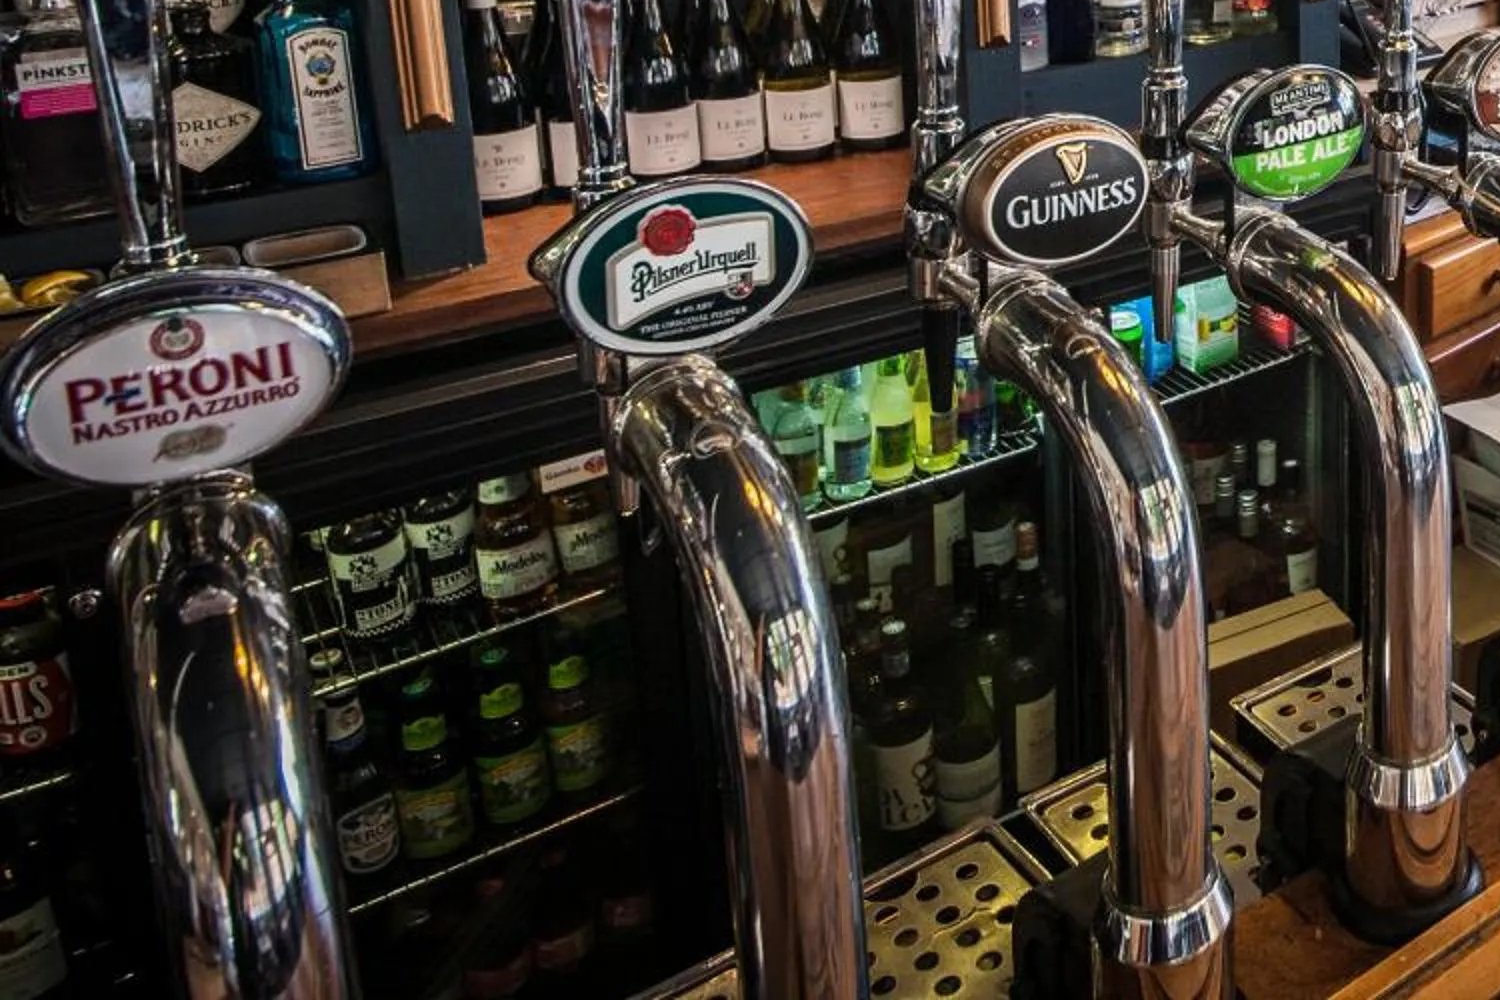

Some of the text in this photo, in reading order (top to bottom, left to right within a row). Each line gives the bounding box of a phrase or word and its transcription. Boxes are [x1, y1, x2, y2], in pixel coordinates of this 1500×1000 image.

[22, 63, 87, 81] PINKST
[177, 111, 251, 134] DRICK'S
[1263, 110, 1344, 149] LONDON
[1256, 134, 1350, 173] PALE ALE
[1006, 177, 1137, 230] GUINNESS
[631, 242, 757, 303] Pilsner Urquell
[65, 341, 296, 425] PERONI
[72, 380, 300, 446] NASTRO AZZURRO
